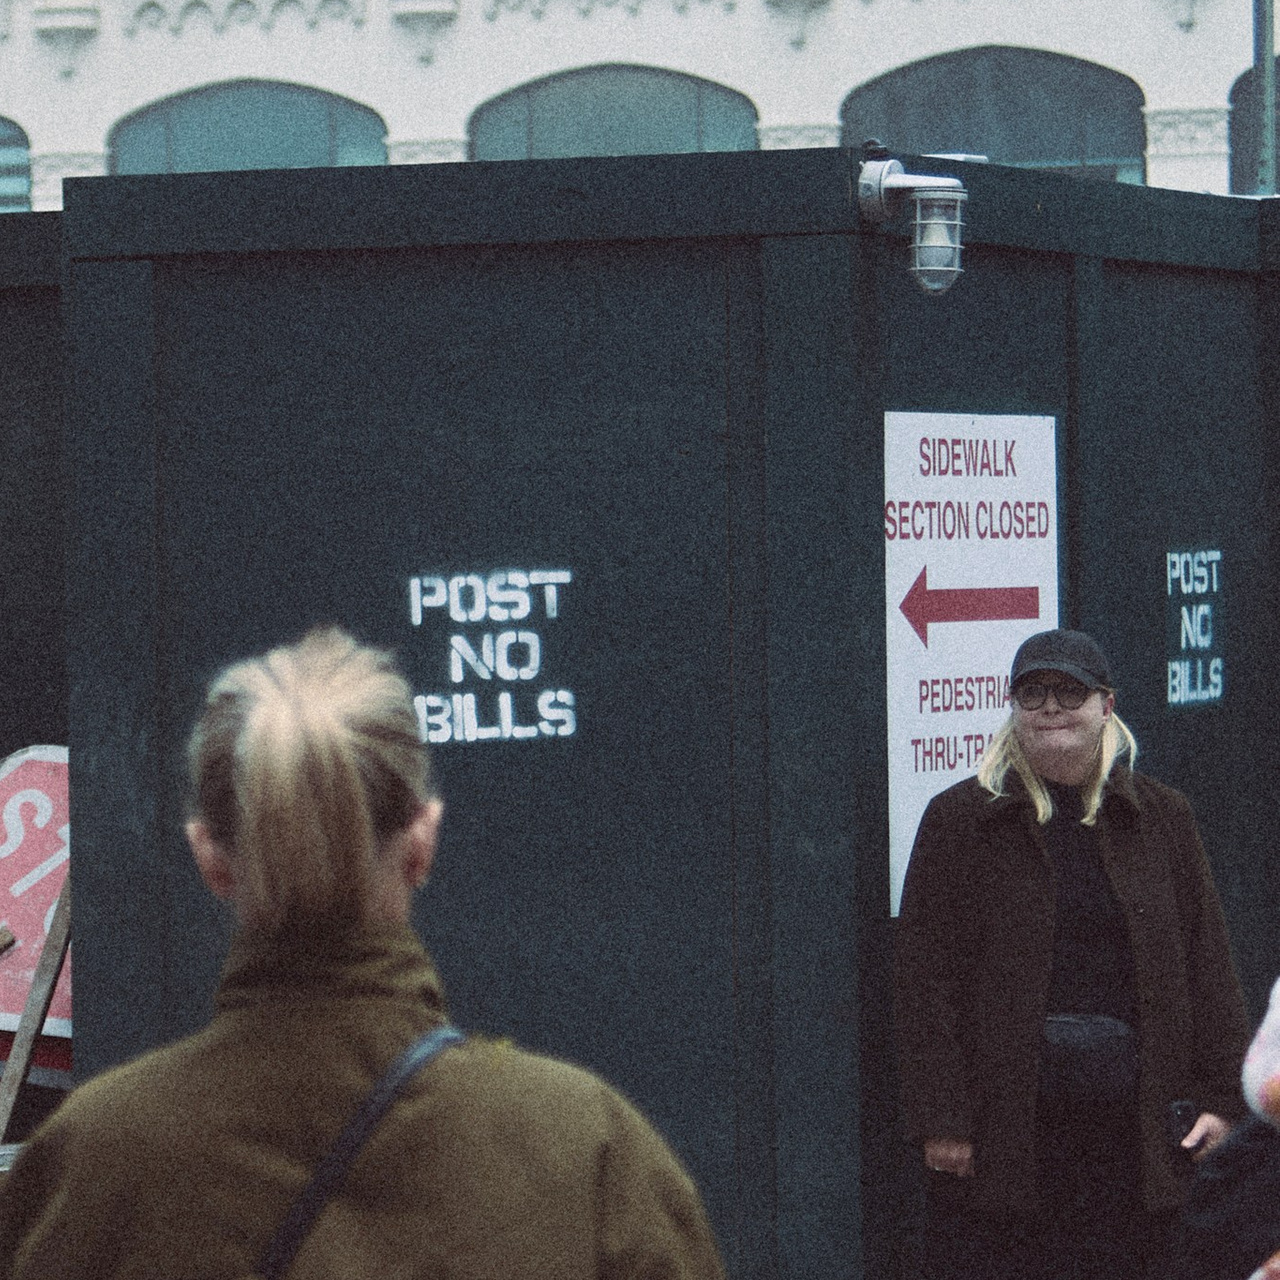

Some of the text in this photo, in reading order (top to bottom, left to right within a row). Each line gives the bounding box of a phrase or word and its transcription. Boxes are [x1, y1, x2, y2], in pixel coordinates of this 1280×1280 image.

[919, 436, 1018, 478] SIDEWALK
[884, 500, 1050, 541] SECTION CLOSED
[1166, 550, 1222, 596] POST
[409, 570, 572, 626] POST
[1180, 603, 1212, 651] NO
[450, 629, 541, 684] NO
[918, 674, 1011, 715] PEDESTRIA
[1167, 657, 1223, 705] BILLS
[413, 689, 577, 744] BILLS
[911, 733, 993, 774] THRU-TR
